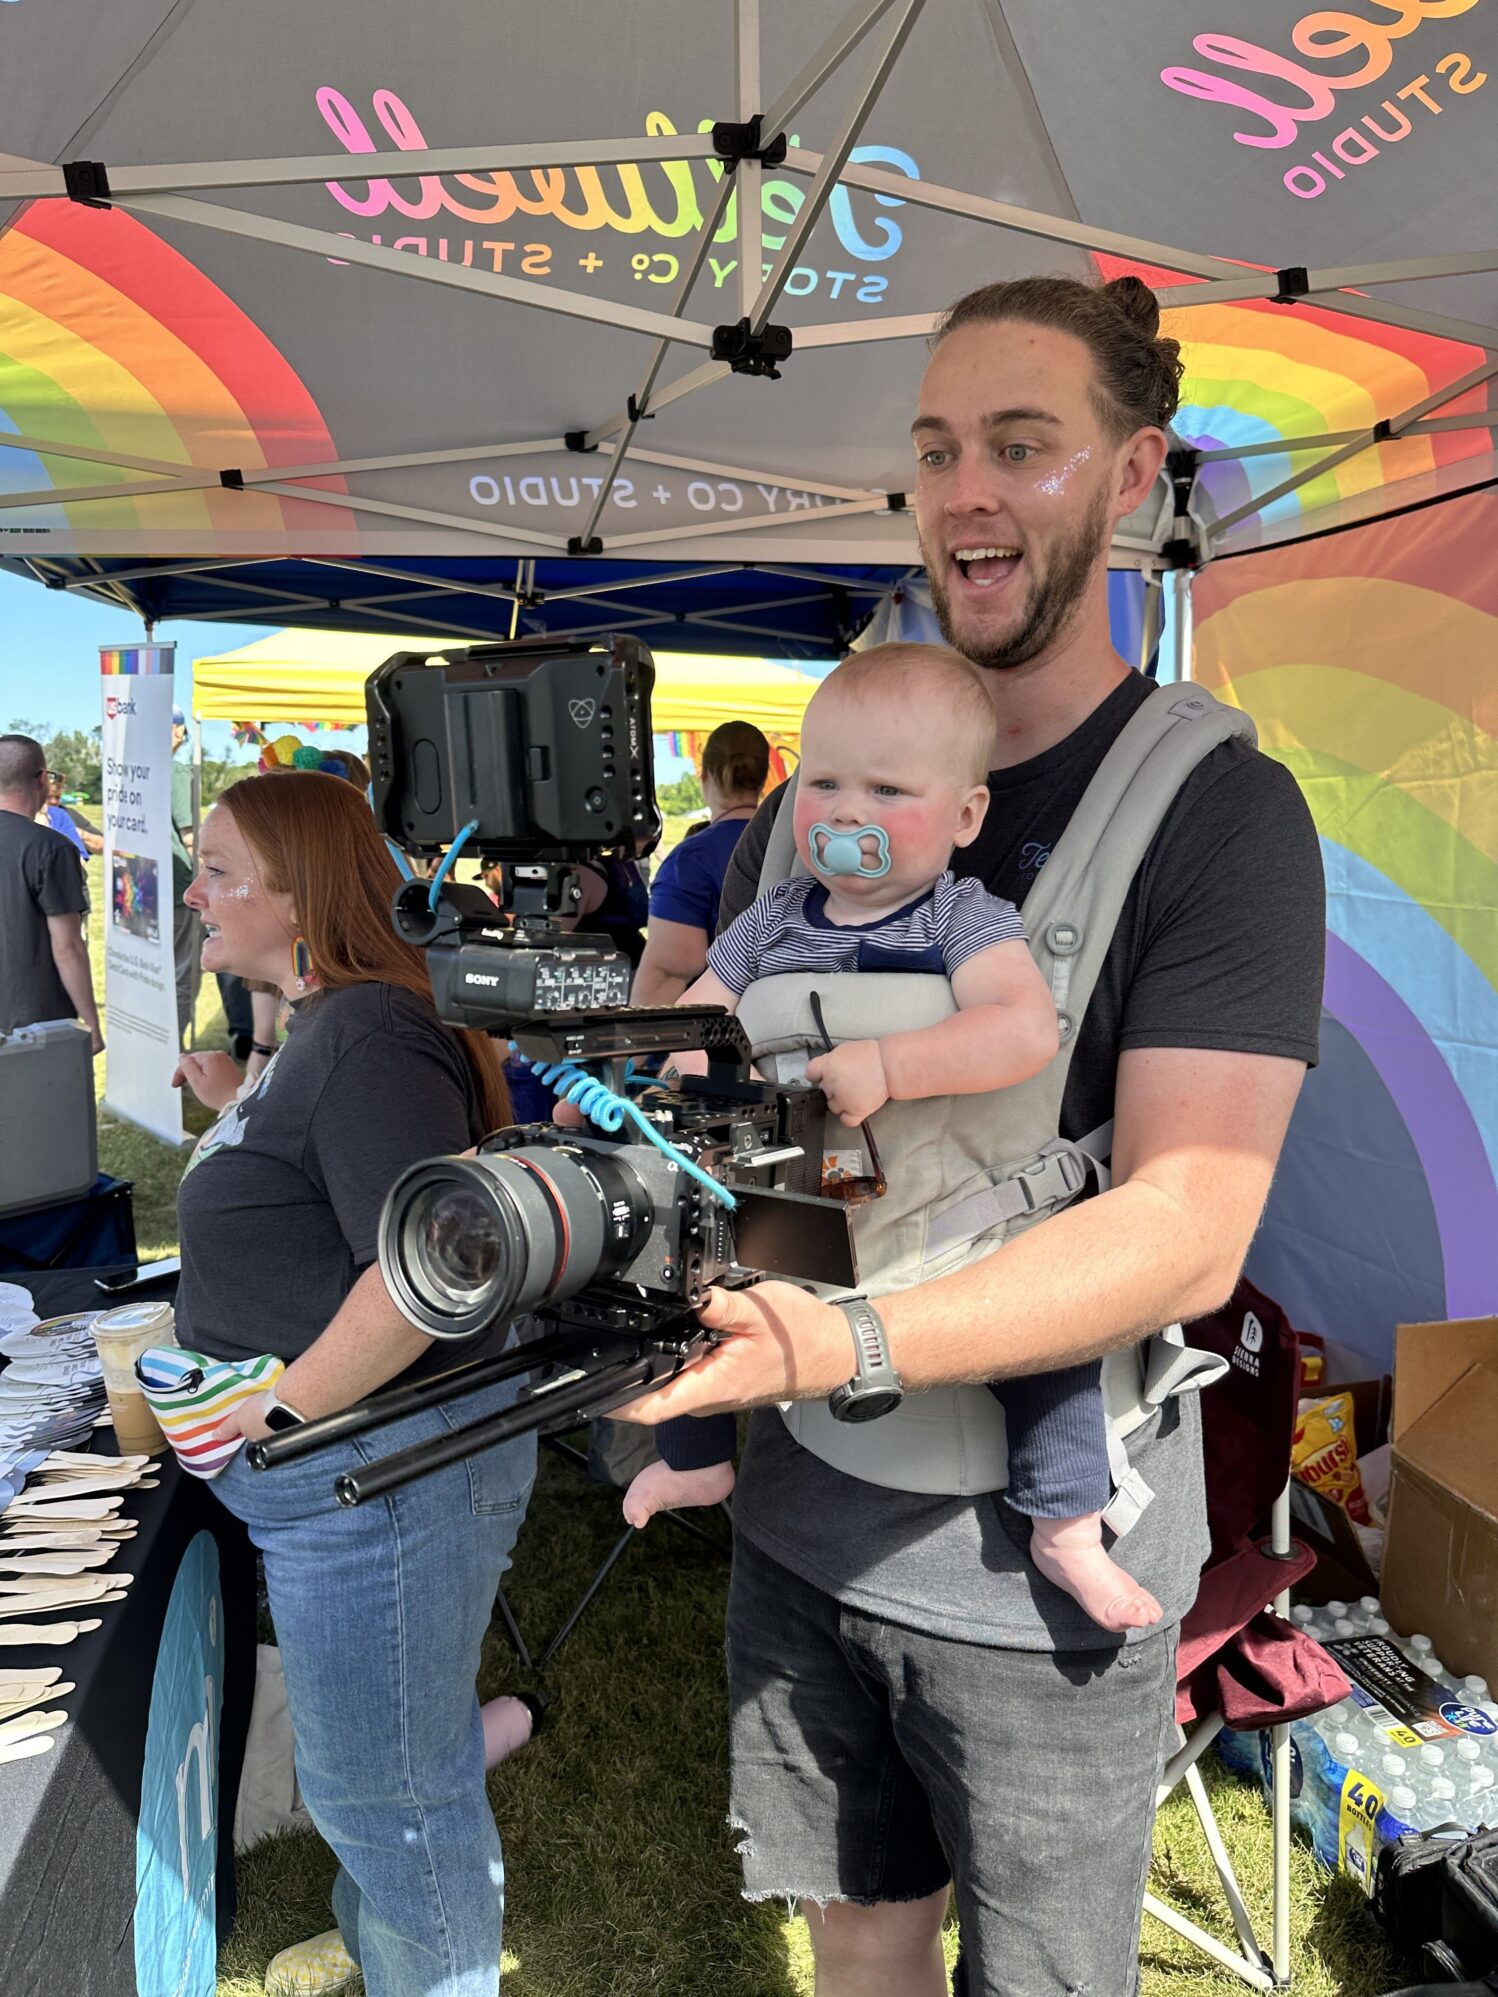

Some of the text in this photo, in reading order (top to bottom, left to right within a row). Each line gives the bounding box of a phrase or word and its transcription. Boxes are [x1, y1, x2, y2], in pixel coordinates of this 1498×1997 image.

[629, 716, 639, 760] ATOMX
[107, 757, 150, 783] Show your
[107, 784, 142, 806] pride on
[107, 813, 125, 831] your
[465, 973, 500, 987] SONY
[1231, 1354, 1260, 1377] DESIGNS
[1233, 1345, 1260, 1369] SIERRA
[1353, 1641, 1395, 1677] VETERANS
[1360, 1640, 1416, 1683] SUPPORTING
[1371, 1638, 1409, 1669] PROUDLY
[1395, 1729, 1417, 1744] 40
[1347, 1782, 1379, 1821] 40
[1346, 1803, 1372, 1832] BOTTLES
